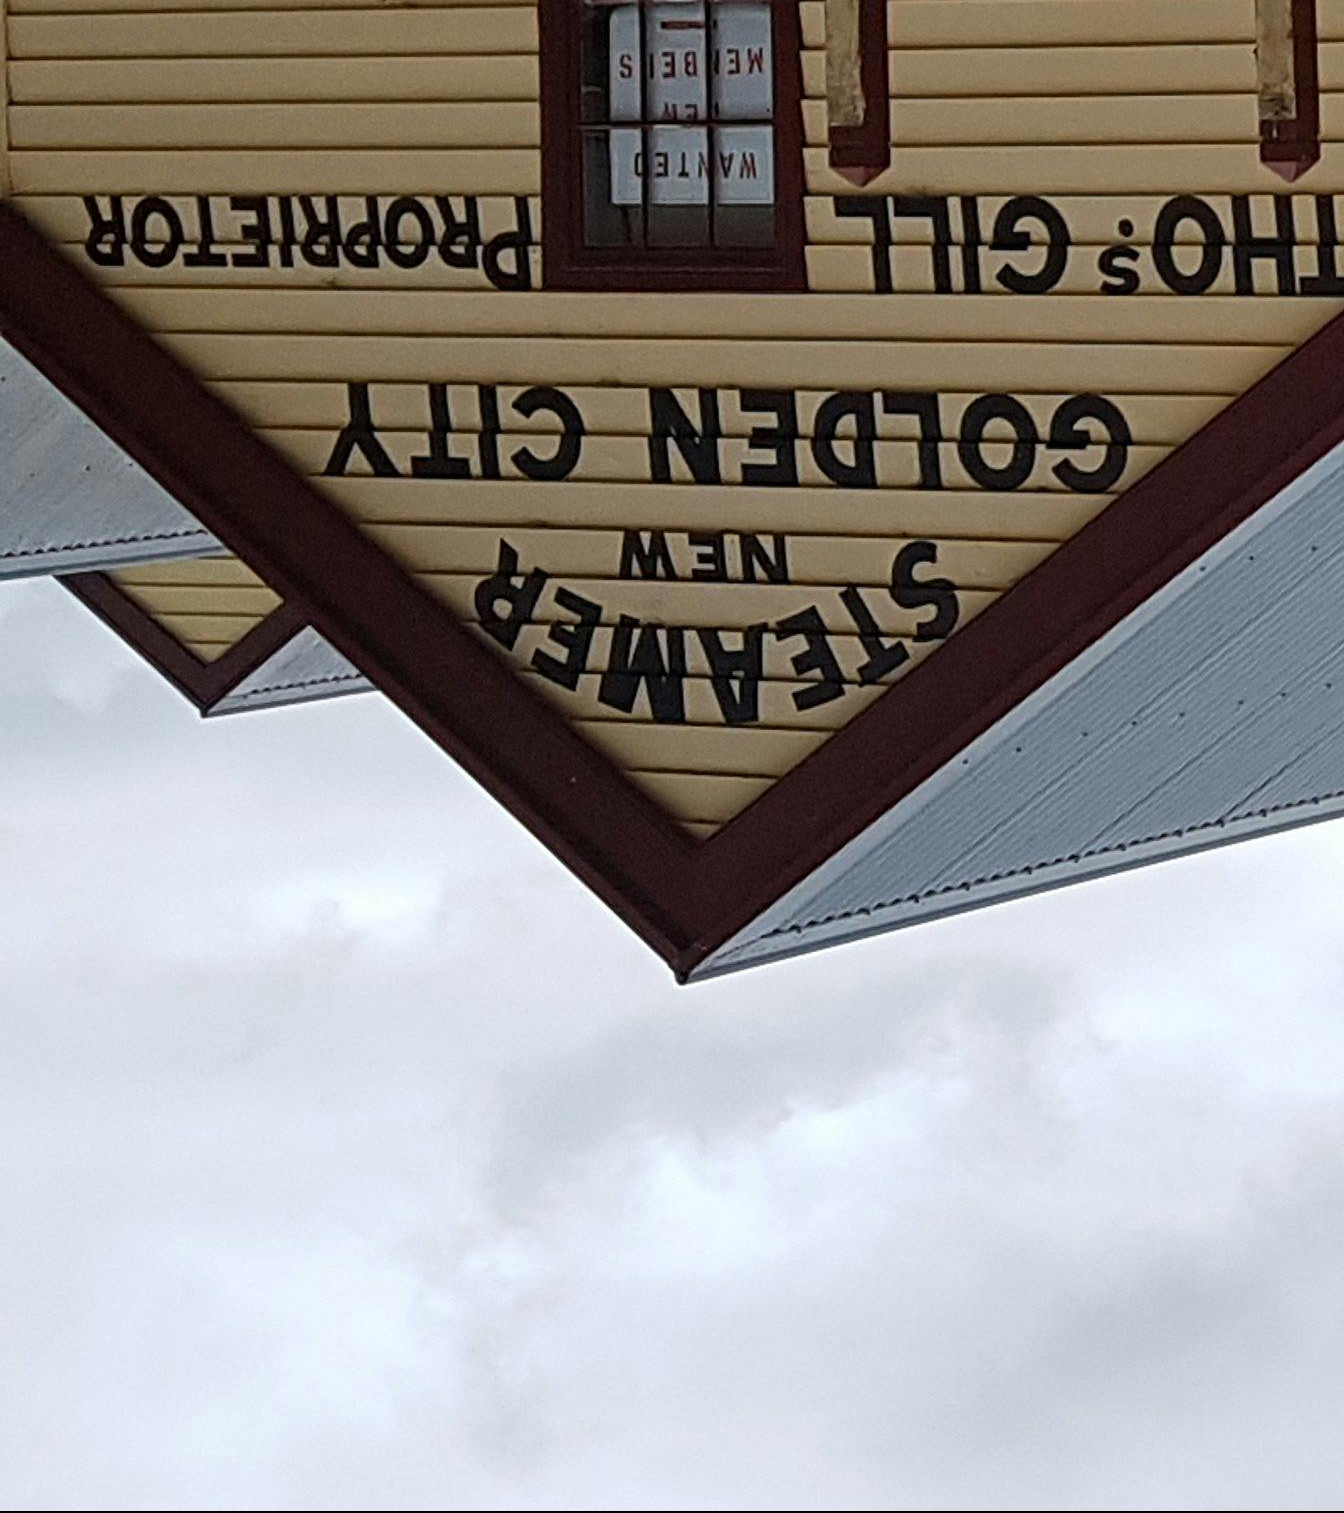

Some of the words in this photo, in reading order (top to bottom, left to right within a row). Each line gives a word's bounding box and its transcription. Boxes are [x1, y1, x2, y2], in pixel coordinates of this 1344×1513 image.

[618, 48, 764, 78] MEBES
[81, 194, 534, 291] PROPRIETOR
[832, 195, 1071, 294] GILL
[321, 382, 585, 482] CITY
[649, 387, 1132, 492] GOLDEN
[619, 529, 787, 582] NEW
[472, 540, 960, 725] STEAMER
